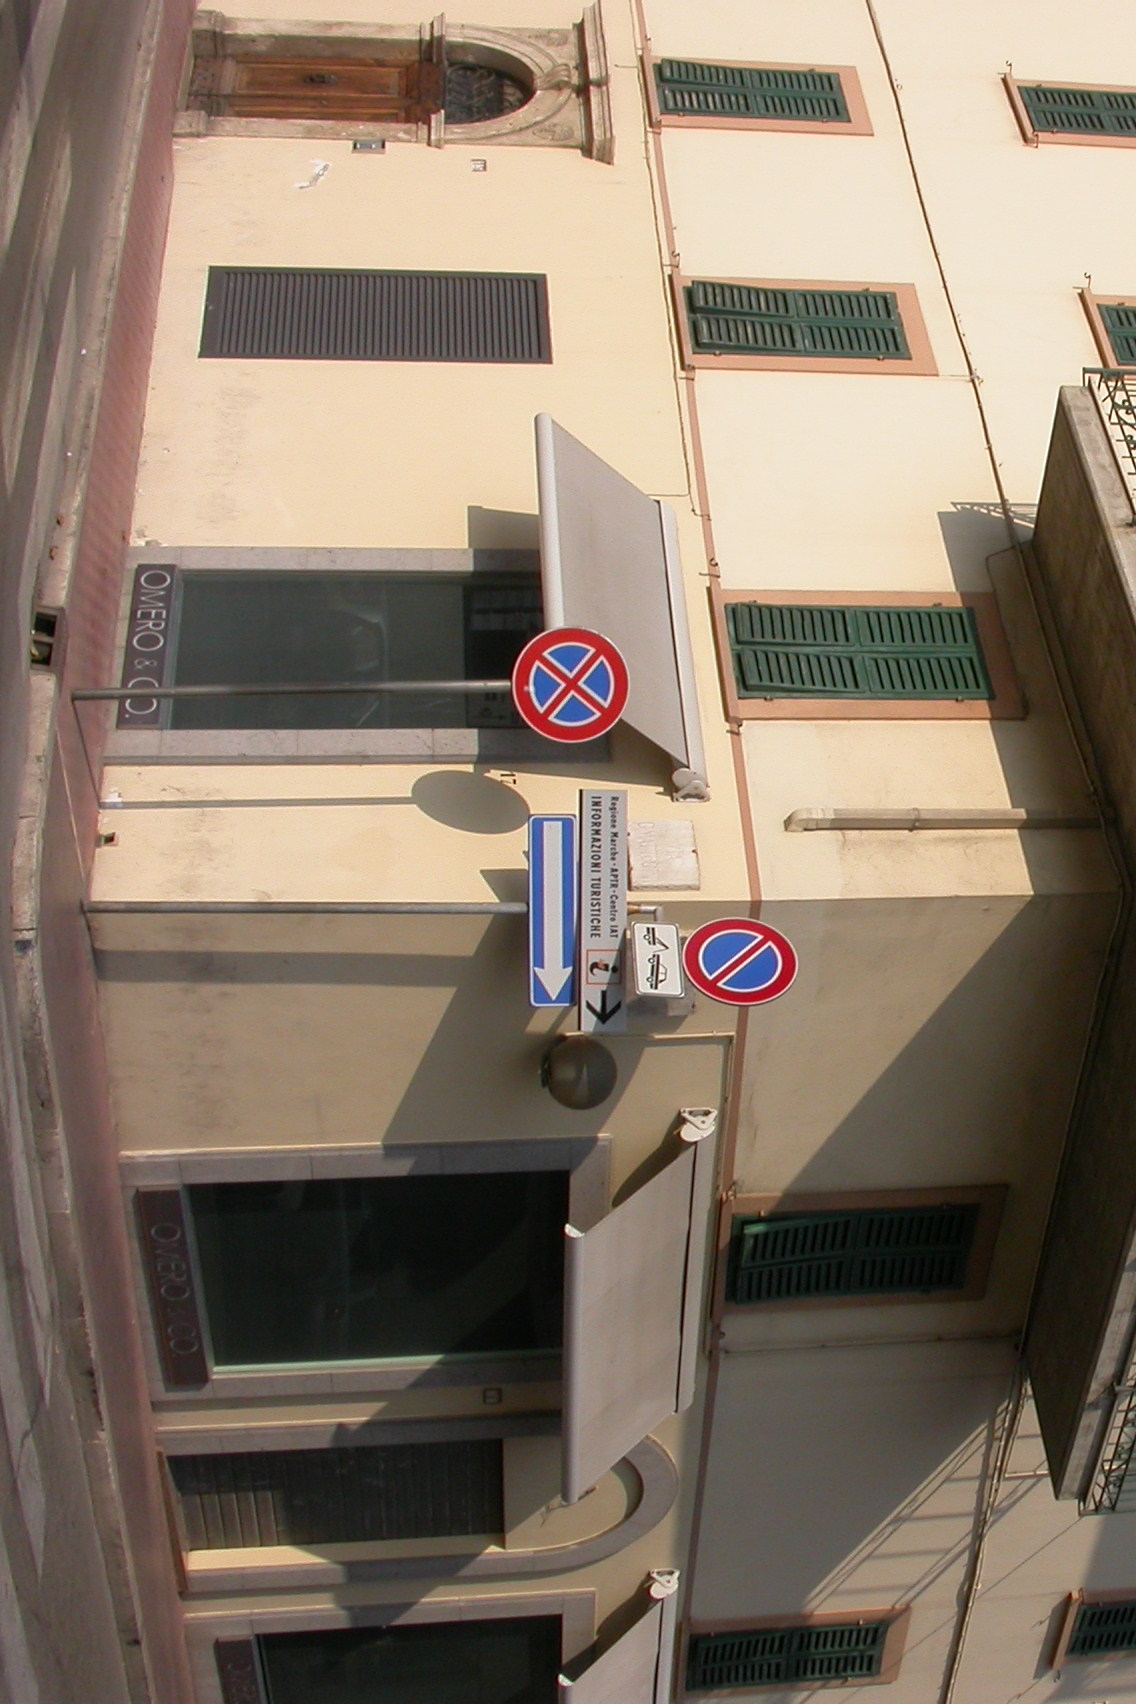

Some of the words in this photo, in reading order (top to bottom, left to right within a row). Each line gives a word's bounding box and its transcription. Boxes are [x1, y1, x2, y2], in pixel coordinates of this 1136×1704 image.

[132, 570, 171, 651] OMERO
[134, 657, 157, 670] &
[591, 796, 602, 873] INFORMAZIONI
[608, 796, 619, 828] Regione
[590, 877, 601, 938] TURISTICHE
[609, 925, 618, 938] IAT
[150, 1223, 191, 1300] OMERO
